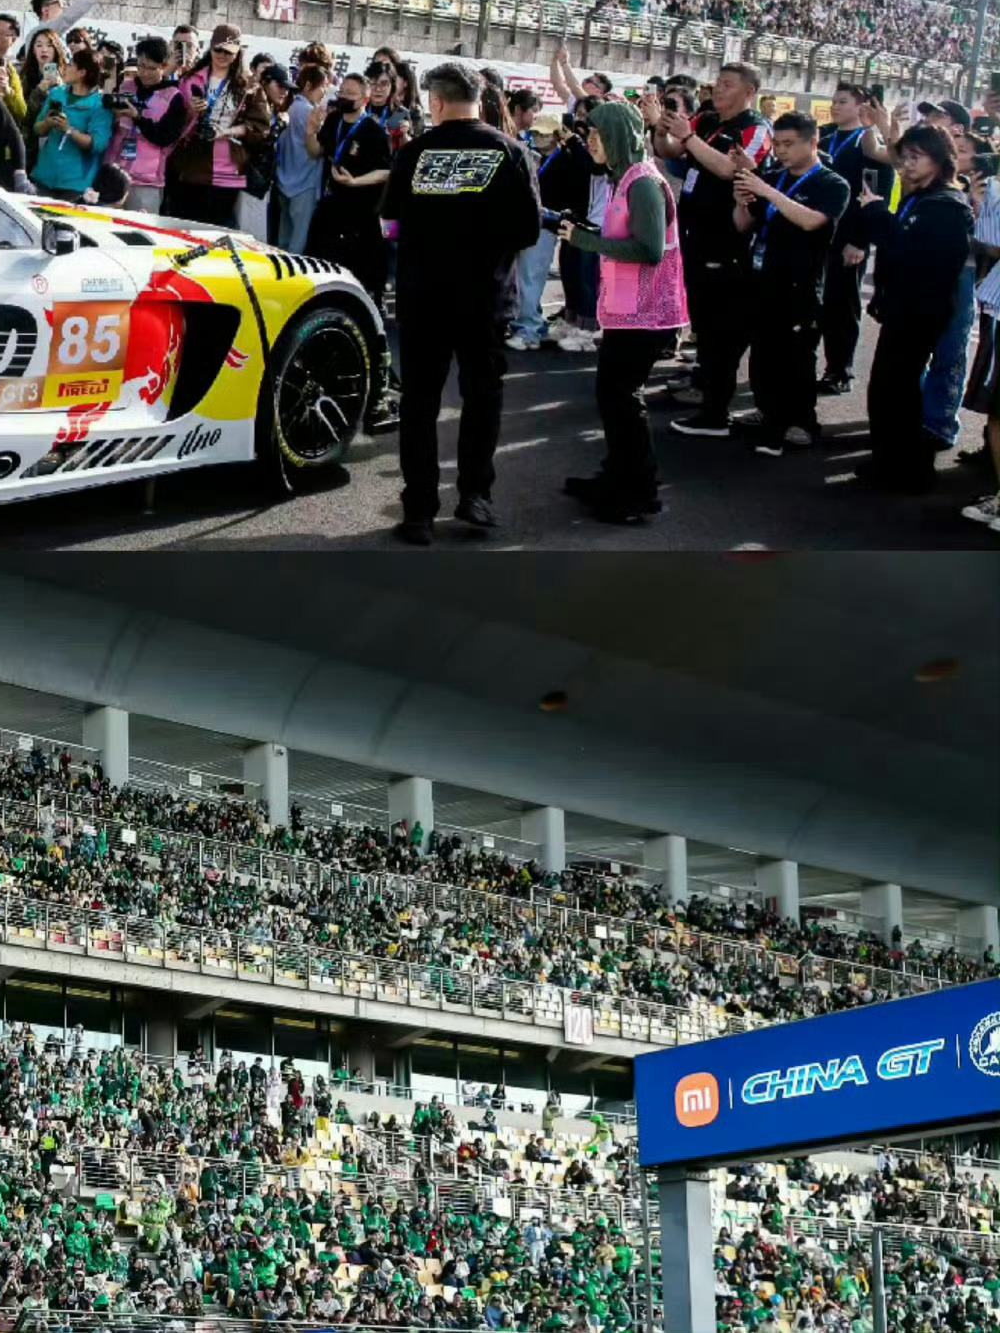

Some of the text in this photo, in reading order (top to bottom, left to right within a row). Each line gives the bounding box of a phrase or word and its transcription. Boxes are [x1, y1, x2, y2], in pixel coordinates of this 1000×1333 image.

[57, 314, 121, 365] 85
[2, 382, 39, 403] GT3
[57, 378, 110, 398] PIRELLI
[741, 1054, 869, 1105] CHINA
[876, 1038, 945, 1081] GT
